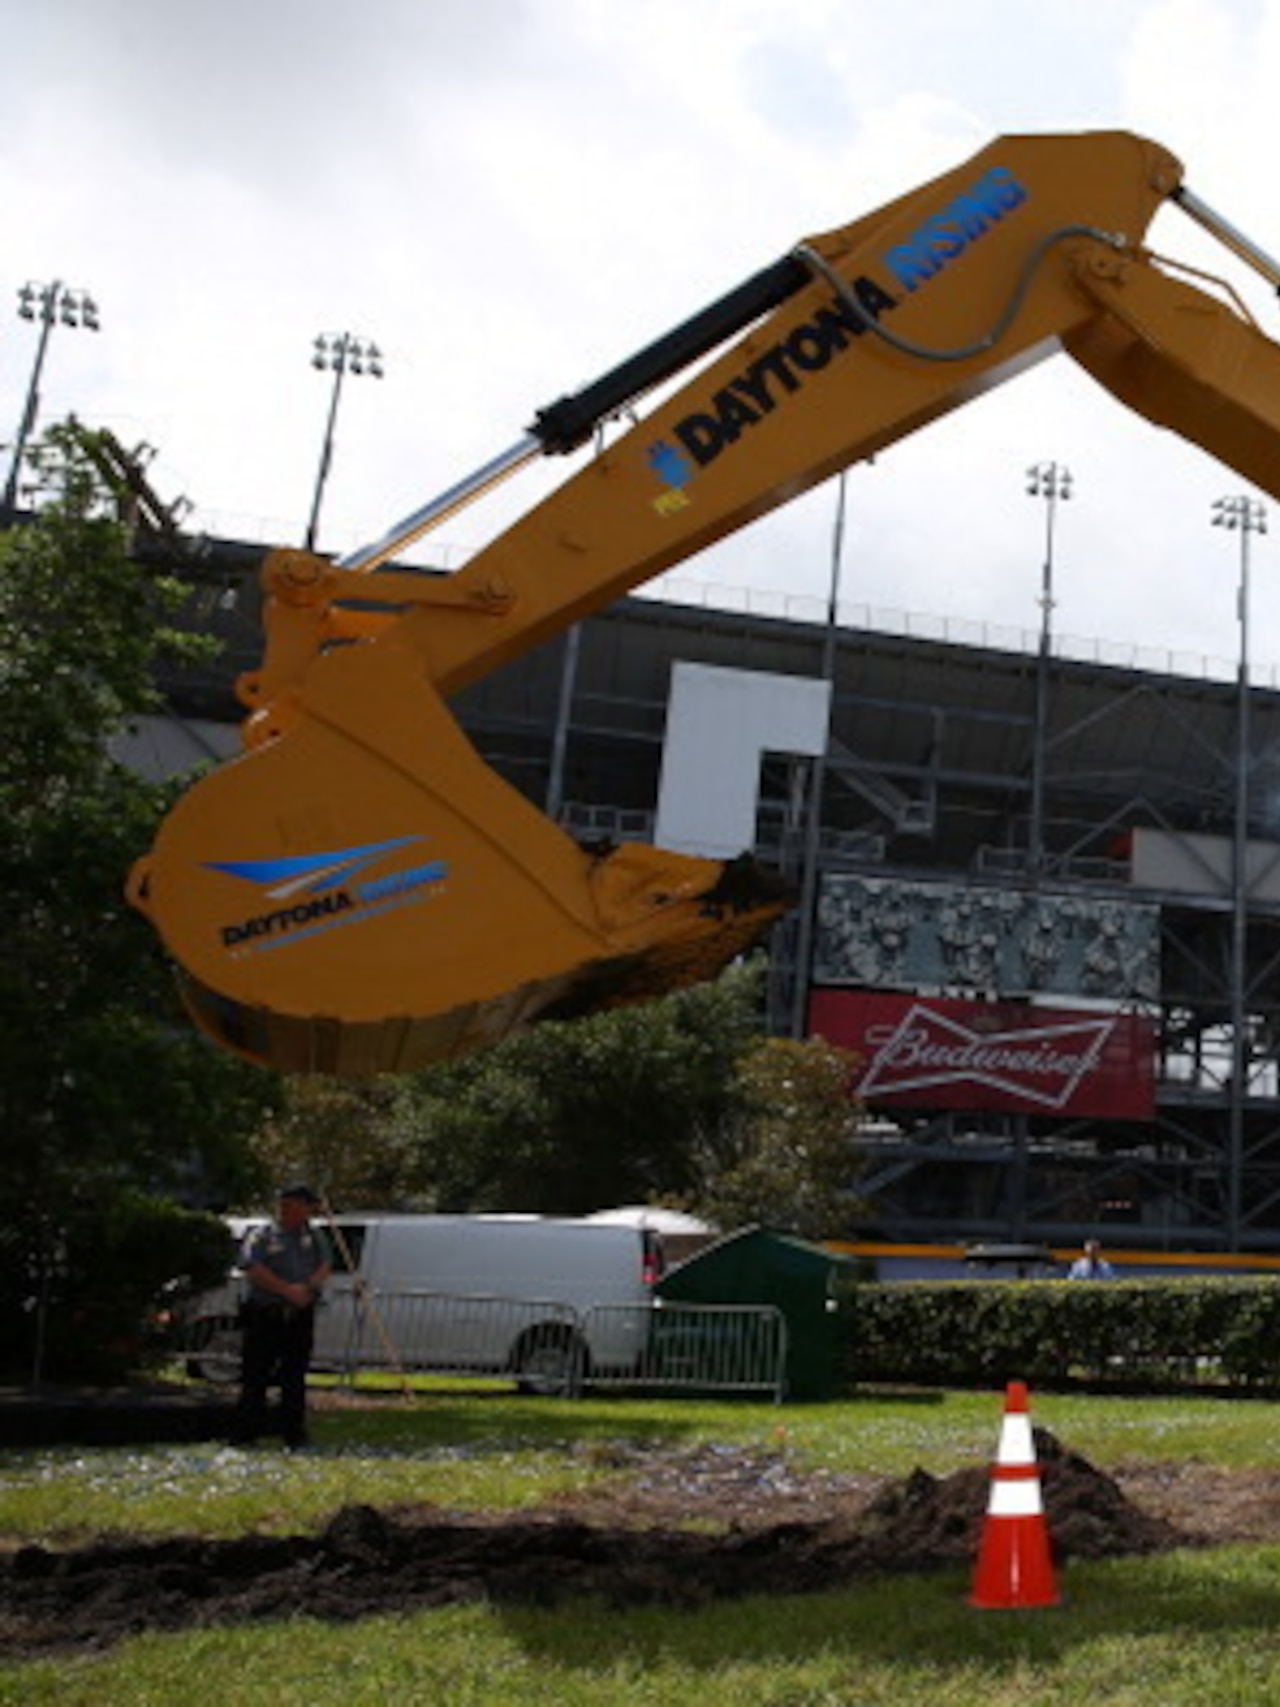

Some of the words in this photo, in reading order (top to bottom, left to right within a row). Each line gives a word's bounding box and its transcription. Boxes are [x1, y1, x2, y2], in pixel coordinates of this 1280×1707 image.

[673, 275, 898, 467] DAYTONA
[221, 891, 355, 947] DAYTONA
[865, 1025, 1101, 1076] Budweiser
